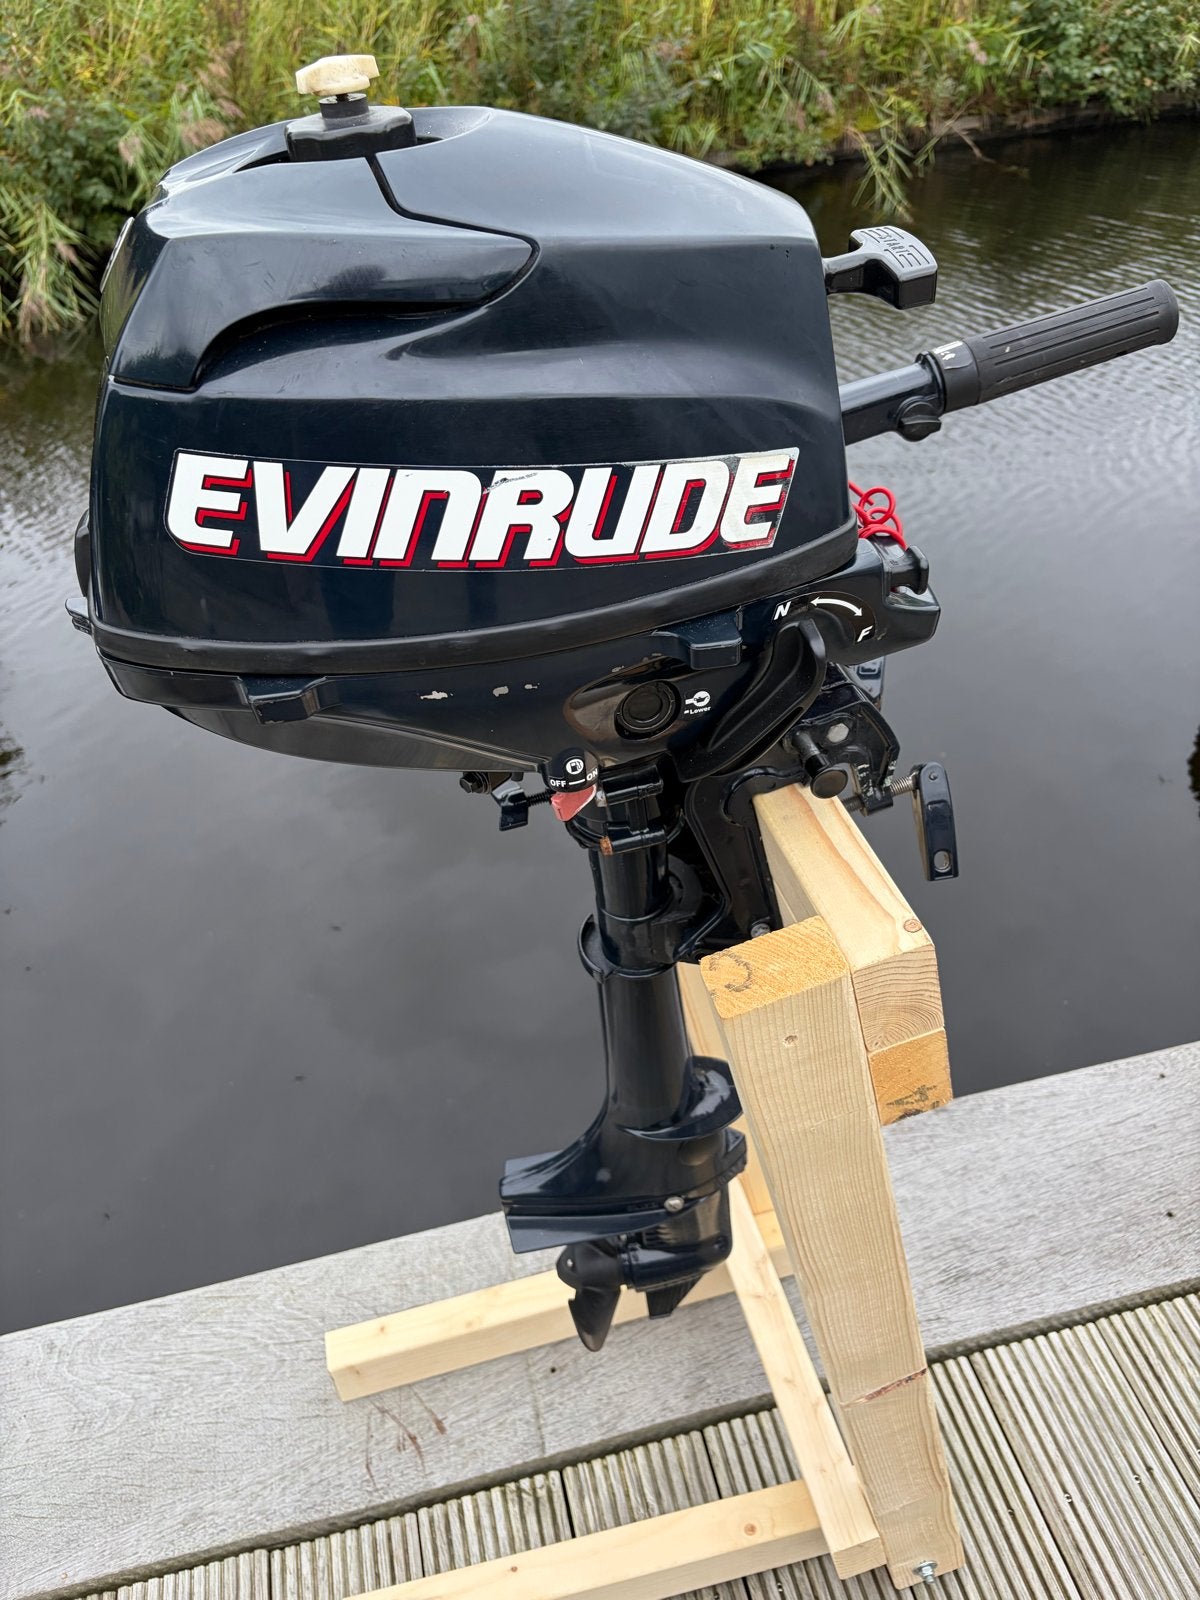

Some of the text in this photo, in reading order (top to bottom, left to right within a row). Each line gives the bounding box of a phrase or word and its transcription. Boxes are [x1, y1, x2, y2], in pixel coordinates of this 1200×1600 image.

[878, 233, 910, 254] START
[167, 453, 796, 567] EVINRUDE
[773, 601, 873, 643] N F
[689, 706, 711, 715] Lower
[550, 768, 598, 788] OFF ON
